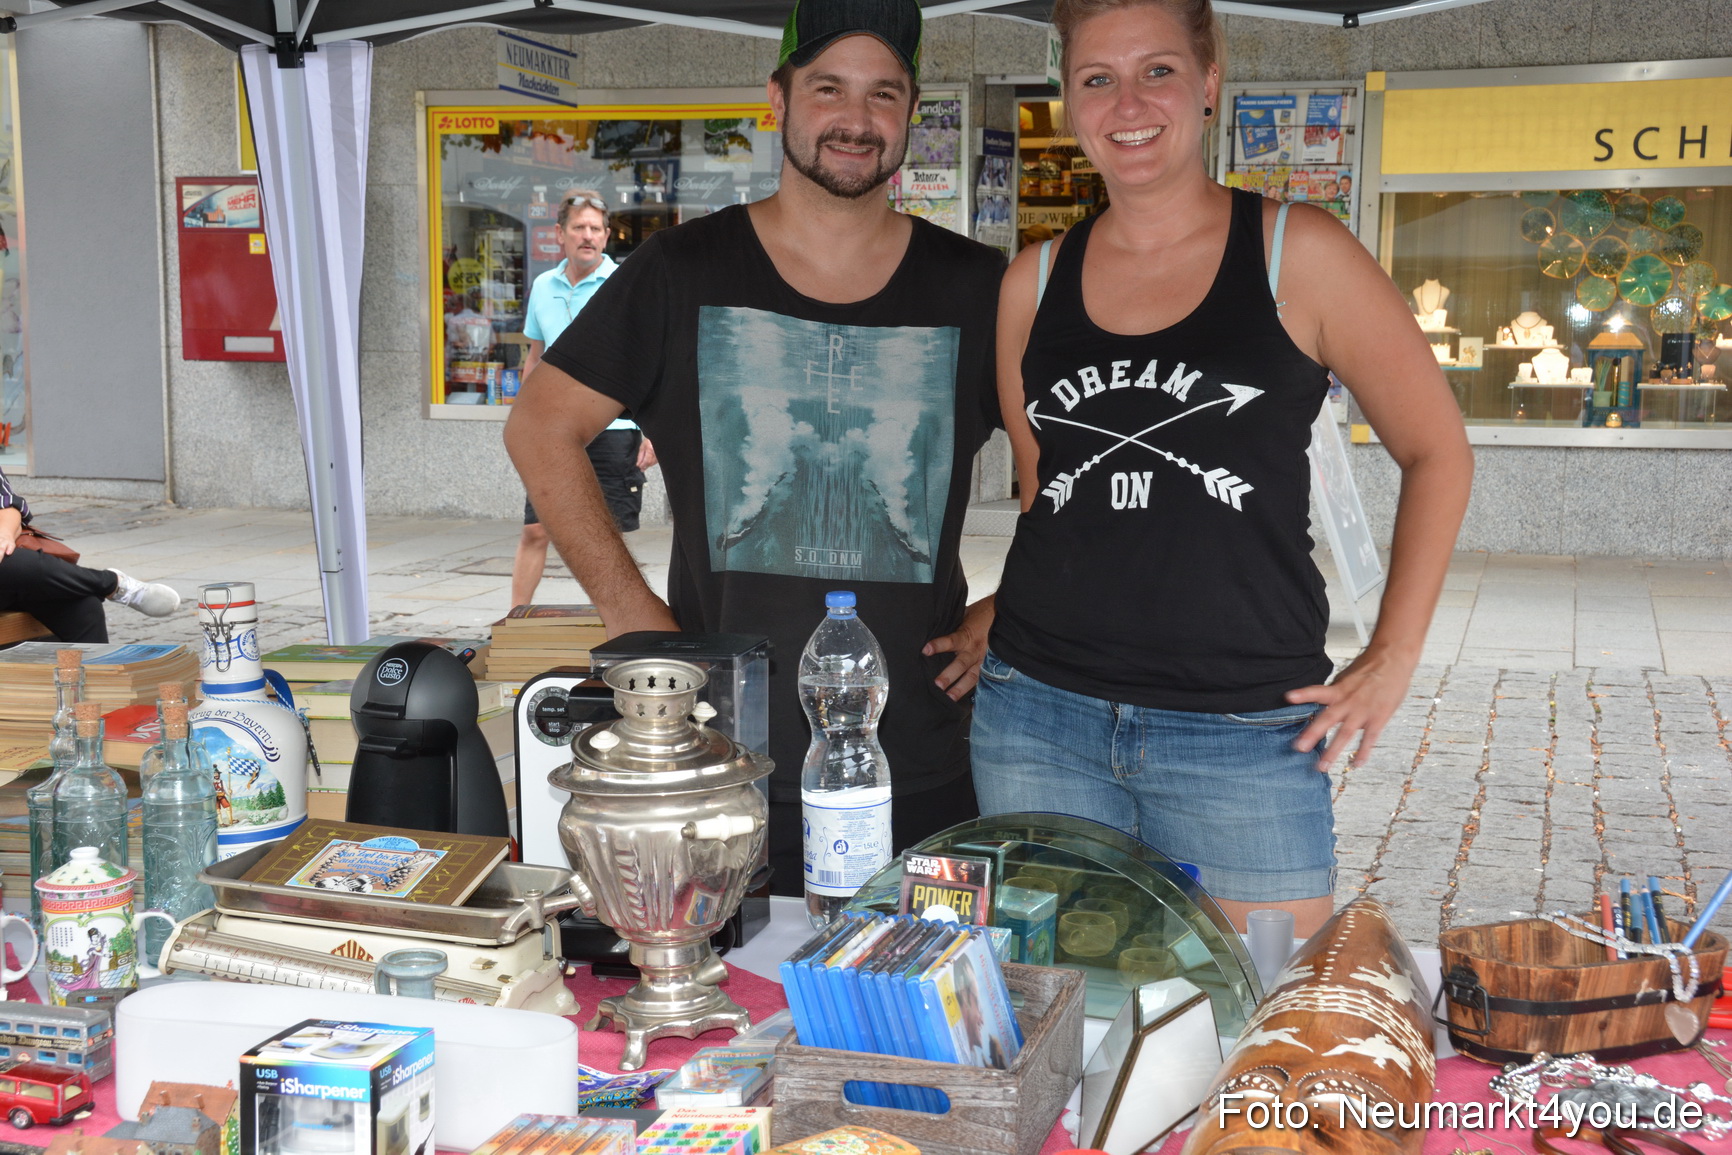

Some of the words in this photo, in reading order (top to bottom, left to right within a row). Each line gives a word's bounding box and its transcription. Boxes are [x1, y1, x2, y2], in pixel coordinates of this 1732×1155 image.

[506, 42, 570, 80] NEUMARKTER
[518, 72, 560, 96] Nachrichten
[455, 117, 495, 129] LOTTO
[1593, 125, 1732, 162] SCH
[913, 172, 939, 182] Asterix
[1050, 359, 1203, 412] DREAM
[1111, 471, 1153, 510] ON
[829, 551, 862, 566] DNM
[380, 672, 401, 680] Gusto
[381, 666, 403, 675] Dolce
[214, 708, 232, 717] der
[907, 857, 939, 868] STAR
[907, 864, 941, 876] WARS
[912, 884, 973, 917] POWER
[335, 1024, 420, 1035] iSharpener
[255, 1068, 278, 1079] USB
[379, 1064, 393, 1079] USB
[392, 1051, 434, 1086] iSharpener
[280, 1077, 367, 1100] iSharpener
